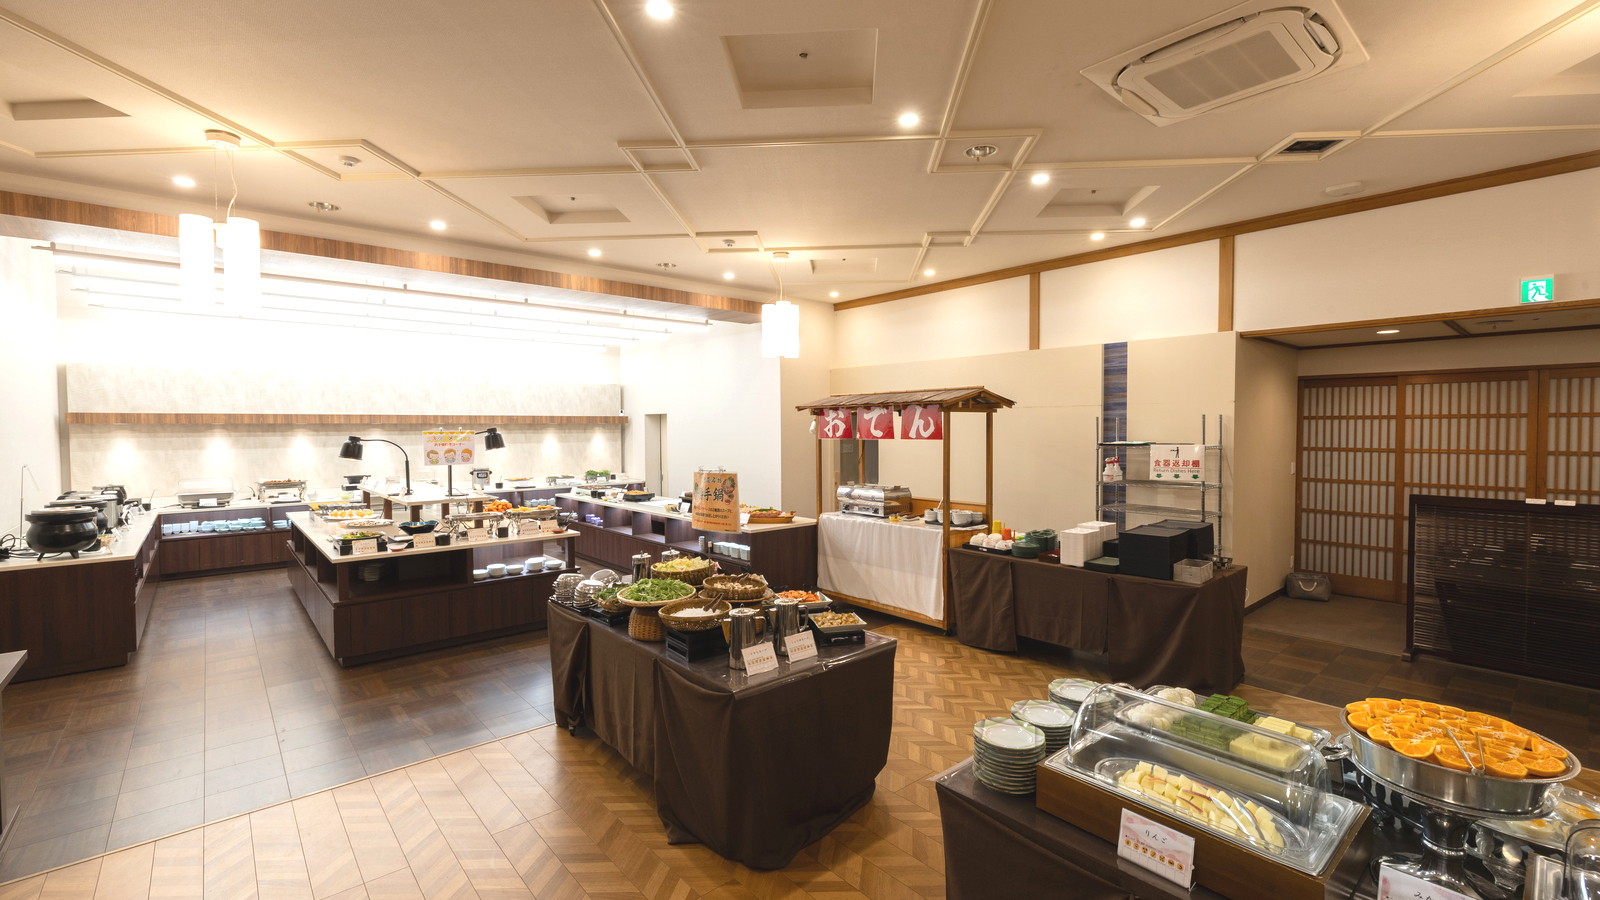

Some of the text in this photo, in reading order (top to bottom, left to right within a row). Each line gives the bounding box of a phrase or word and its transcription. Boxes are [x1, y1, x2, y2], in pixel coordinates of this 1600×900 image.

[823, 406, 935, 438] おでん
[1154, 459, 1200, 468] 食器返却棚
[1145, 829, 1168, 845] りんご
